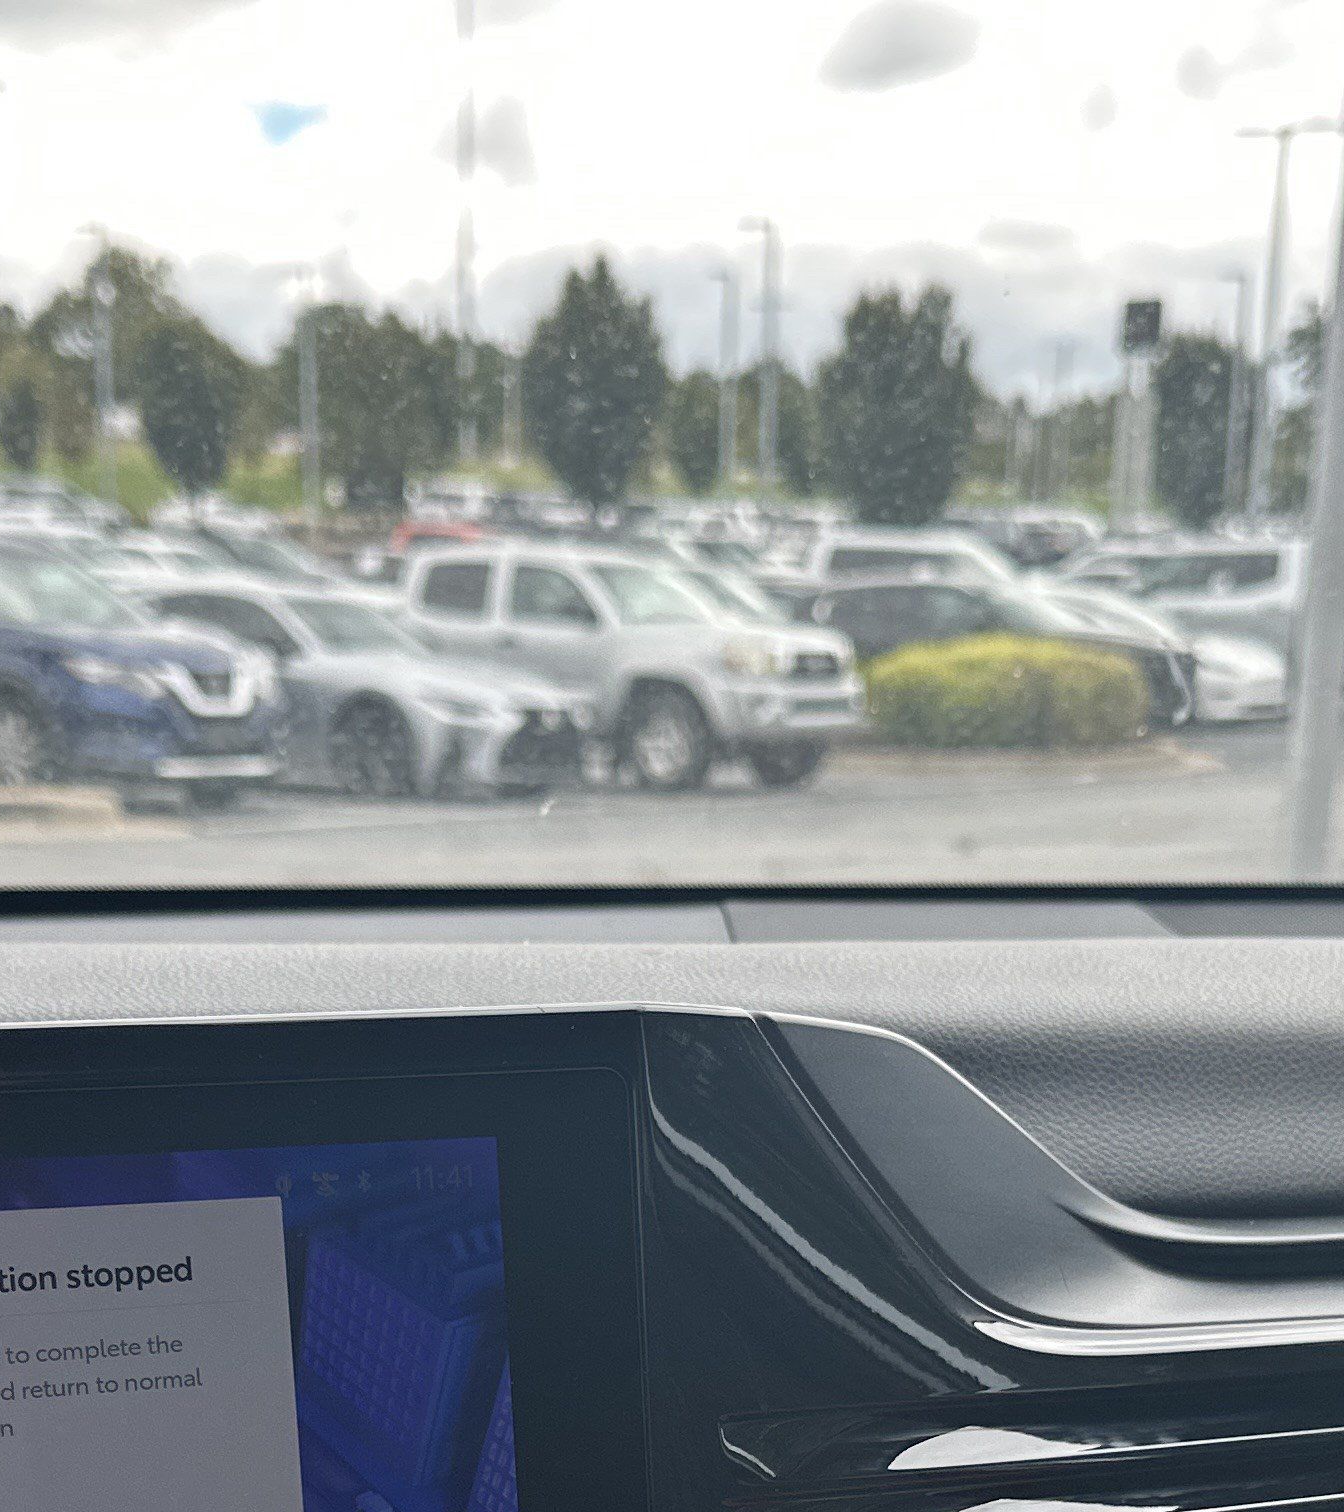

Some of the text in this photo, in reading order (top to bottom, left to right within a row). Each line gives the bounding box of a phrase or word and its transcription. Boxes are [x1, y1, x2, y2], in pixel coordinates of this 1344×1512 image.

[67, 1256, 193, 1292] stopped
[6, 1348, 30, 1365] to
[36, 1339, 141, 1364] complete
[147, 1335, 183, 1354] the
[22, 1380, 89, 1400] return
[96, 1377, 119, 1394] to
[125, 1367, 203, 1391] normal
